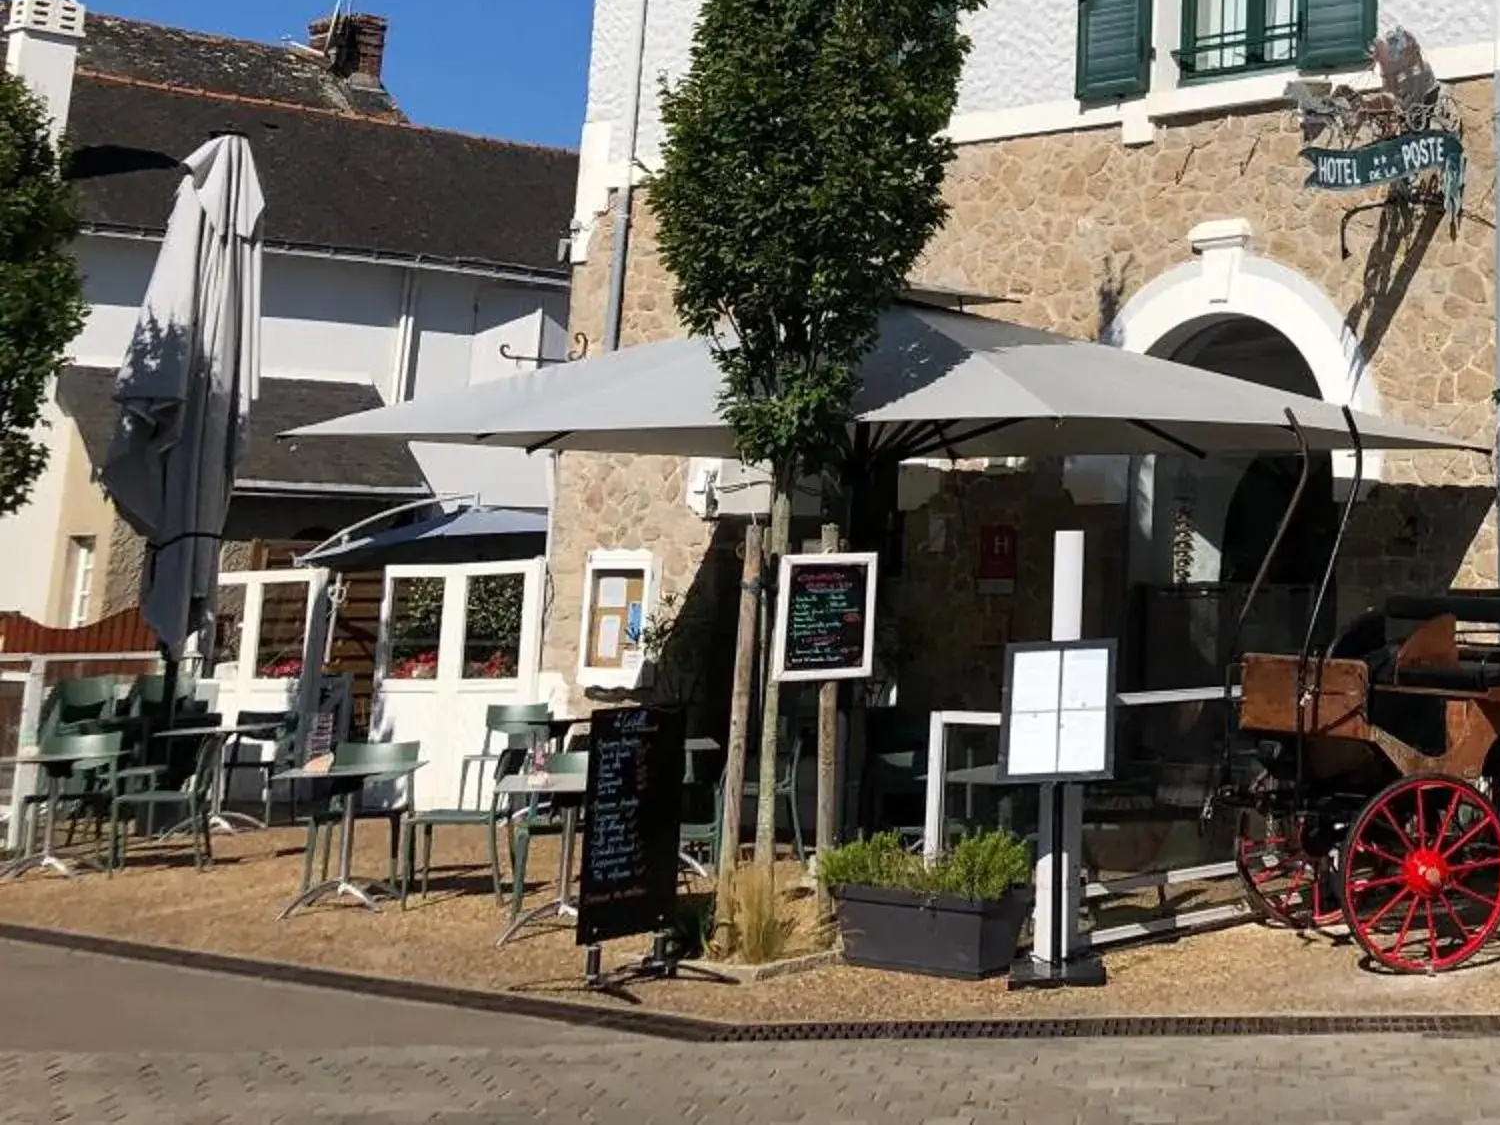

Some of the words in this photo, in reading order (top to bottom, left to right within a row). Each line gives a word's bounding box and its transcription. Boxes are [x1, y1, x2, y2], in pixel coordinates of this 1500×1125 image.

[1317, 156, 1361, 184] HOTEL
[1368, 169, 1381, 182] DE
[1384, 166, 1398, 178] LA
[1401, 136, 1445, 171] POSTE
